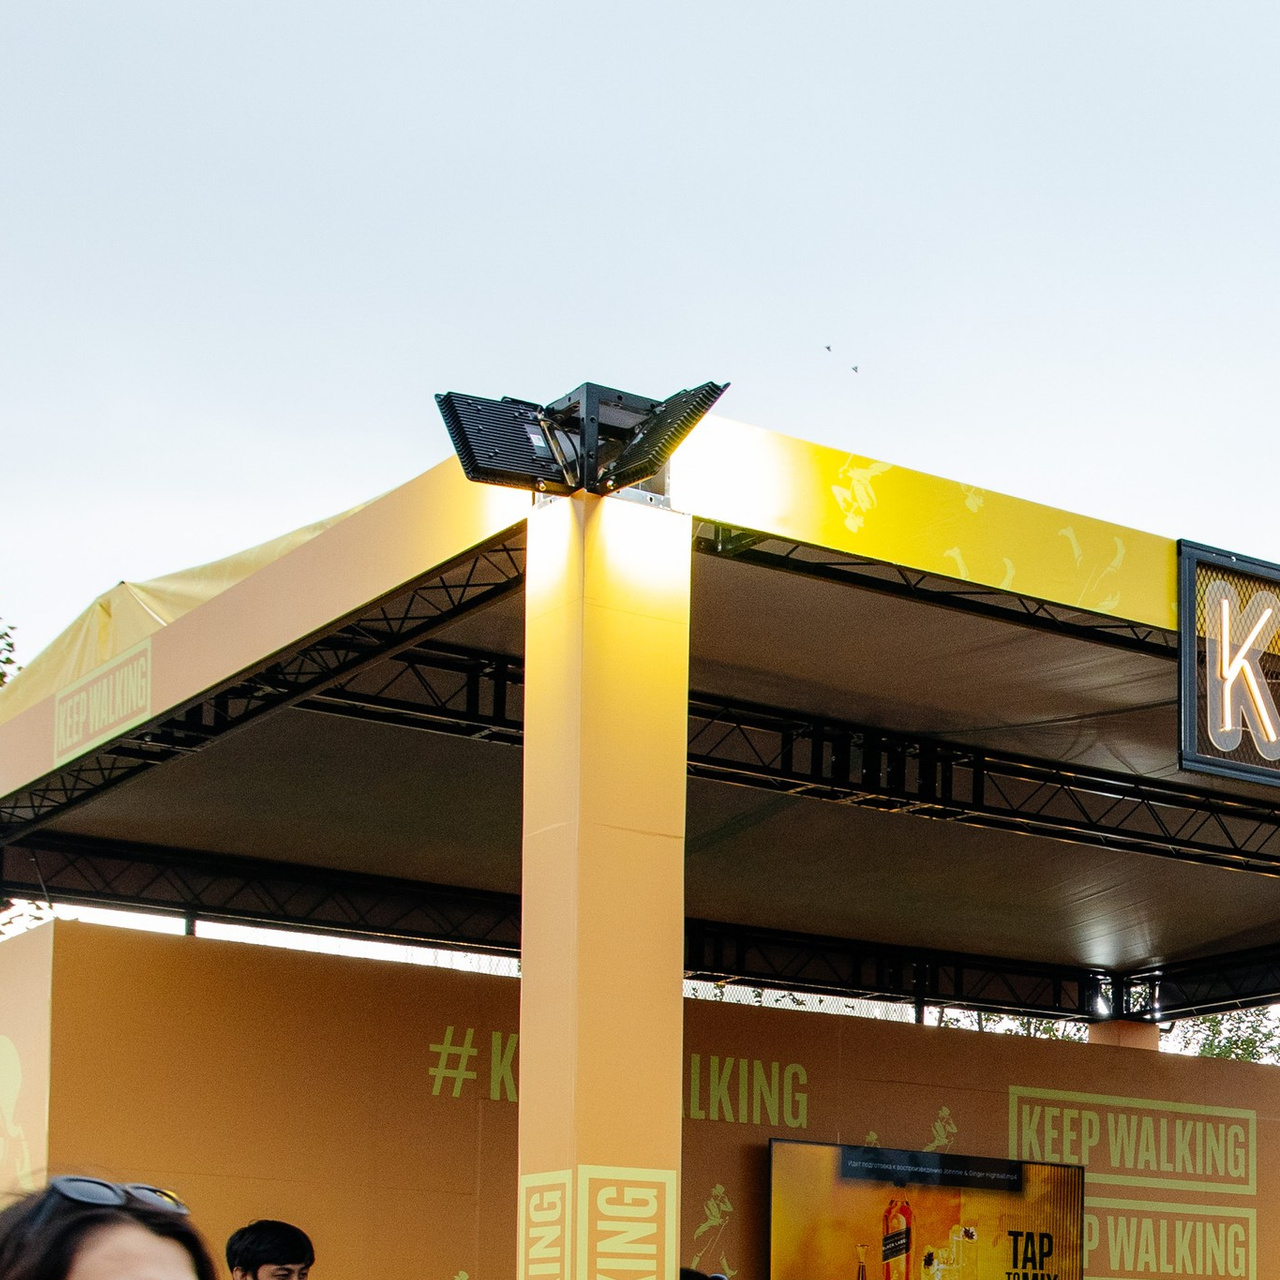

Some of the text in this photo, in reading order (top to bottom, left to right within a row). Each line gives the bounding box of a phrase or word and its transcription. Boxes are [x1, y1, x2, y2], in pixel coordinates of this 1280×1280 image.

[58, 656, 146, 752] KEEP WALKING
[1021, 1104, 1246, 1178] KEEP WALKING
[1007, 1230, 1054, 1271] TAP
[1107, 1215, 1246, 1278] WALKING
